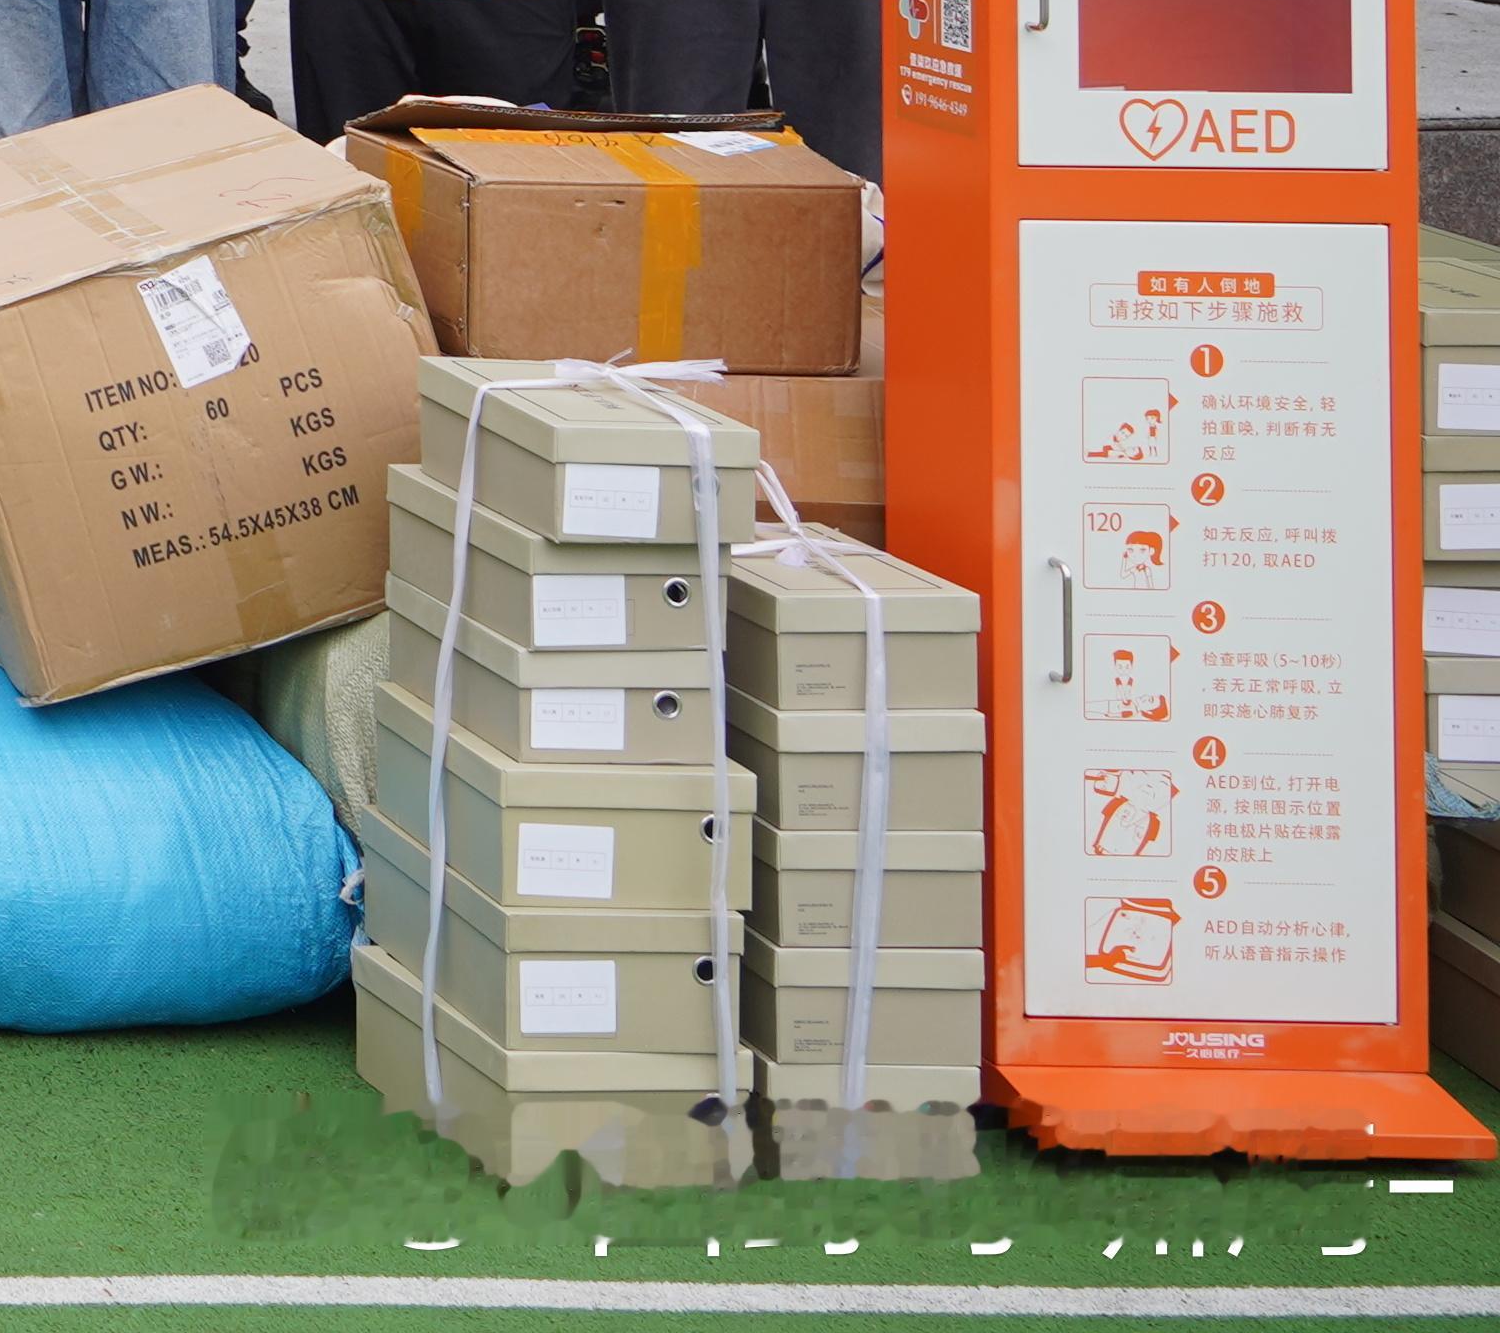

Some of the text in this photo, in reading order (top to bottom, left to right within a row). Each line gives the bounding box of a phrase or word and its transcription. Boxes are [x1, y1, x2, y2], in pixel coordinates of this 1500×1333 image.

[912, 68, 950, 89] emergency
[949, 77, 972, 94] rescue
[1190, 109, 1296, 154] AED
[1150, 276, 1262, 295] 如有人倒地
[1108, 299, 1305, 324] 请按如下步骤施救
[85, 383, 135, 413] ITEM
[140, 370, 177, 398] NO:
[99, 368, 323, 452] QTY: 60 PCS
[290, 407, 336, 438] KGS
[302, 446, 348, 477] KGS
[1201, 445, 1237, 462] 反应
[133, 483, 361, 569] MEAS.: 54.5X45X38 CM
[1087, 512, 1122, 532] 120
[1203, 703, 1319, 720] 即实施心肺复苏
[1206, 822, 1341, 841] 将电极片贴在裸露
[1206, 846, 1274, 863] 的皮肤上
[1205, 944, 1347, 964] 听从语音指示操作
